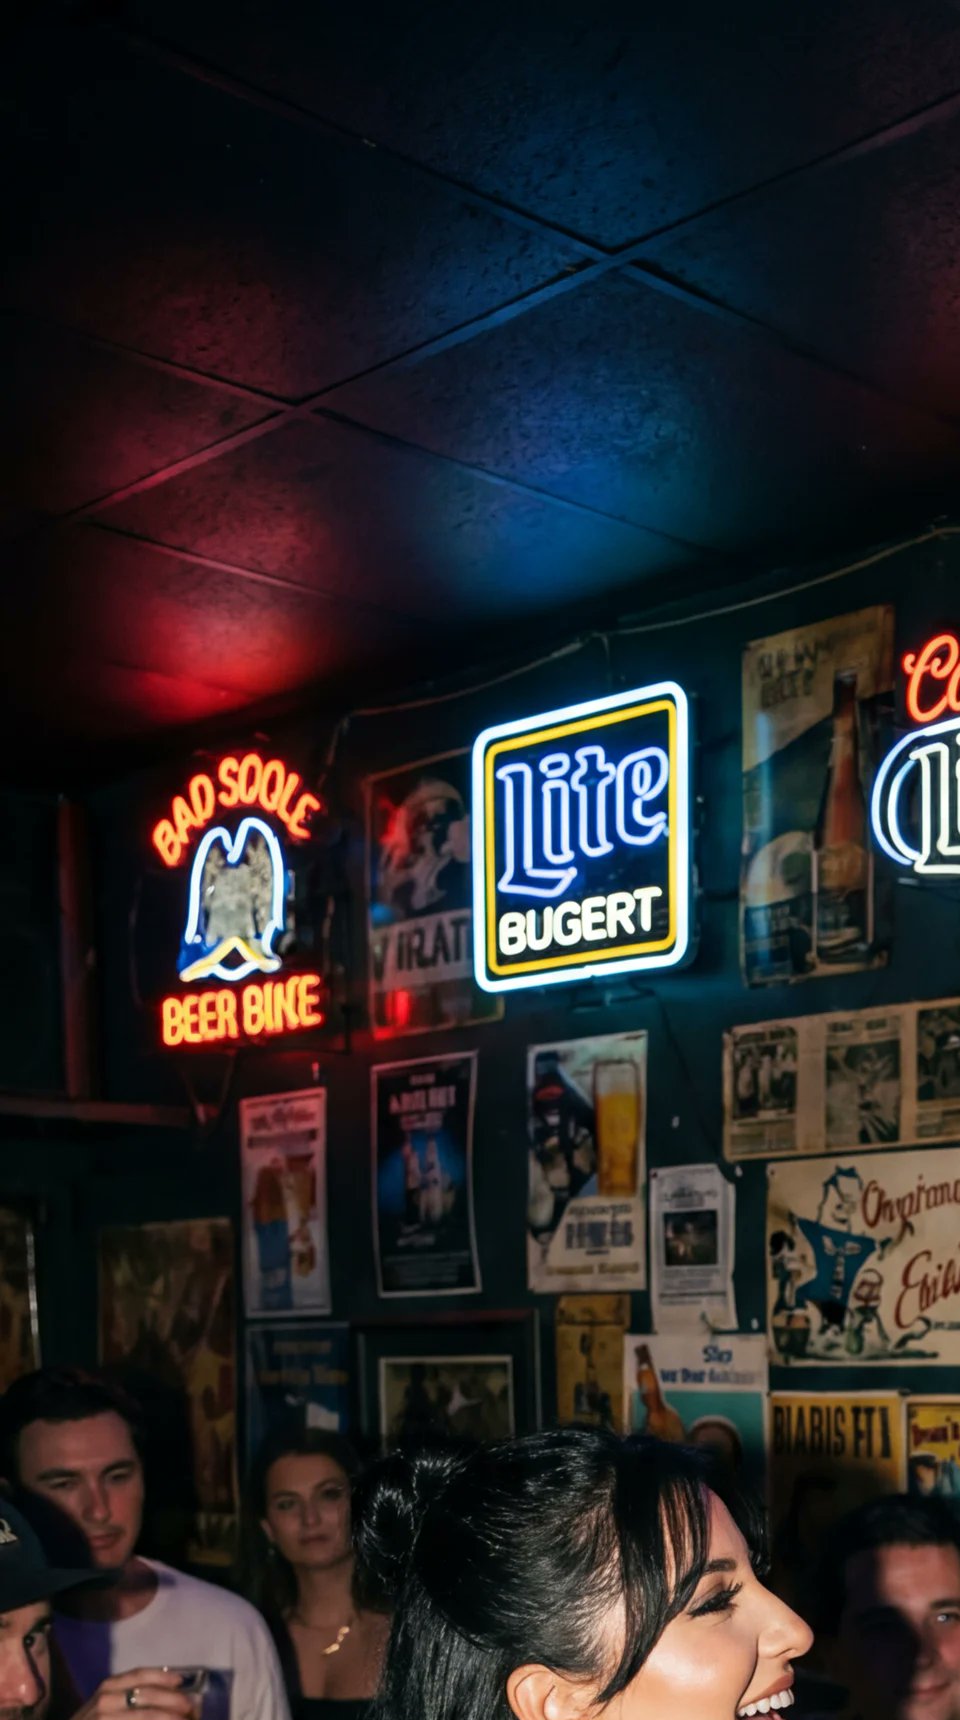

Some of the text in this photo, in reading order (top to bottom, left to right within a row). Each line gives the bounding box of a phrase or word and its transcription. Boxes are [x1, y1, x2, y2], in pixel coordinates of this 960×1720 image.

[152, 773, 216, 867] BAD
[496, 745, 670, 898] Lite
[498, 886, 663, 956] BUGERT
[161, 988, 240, 1046] BEER
